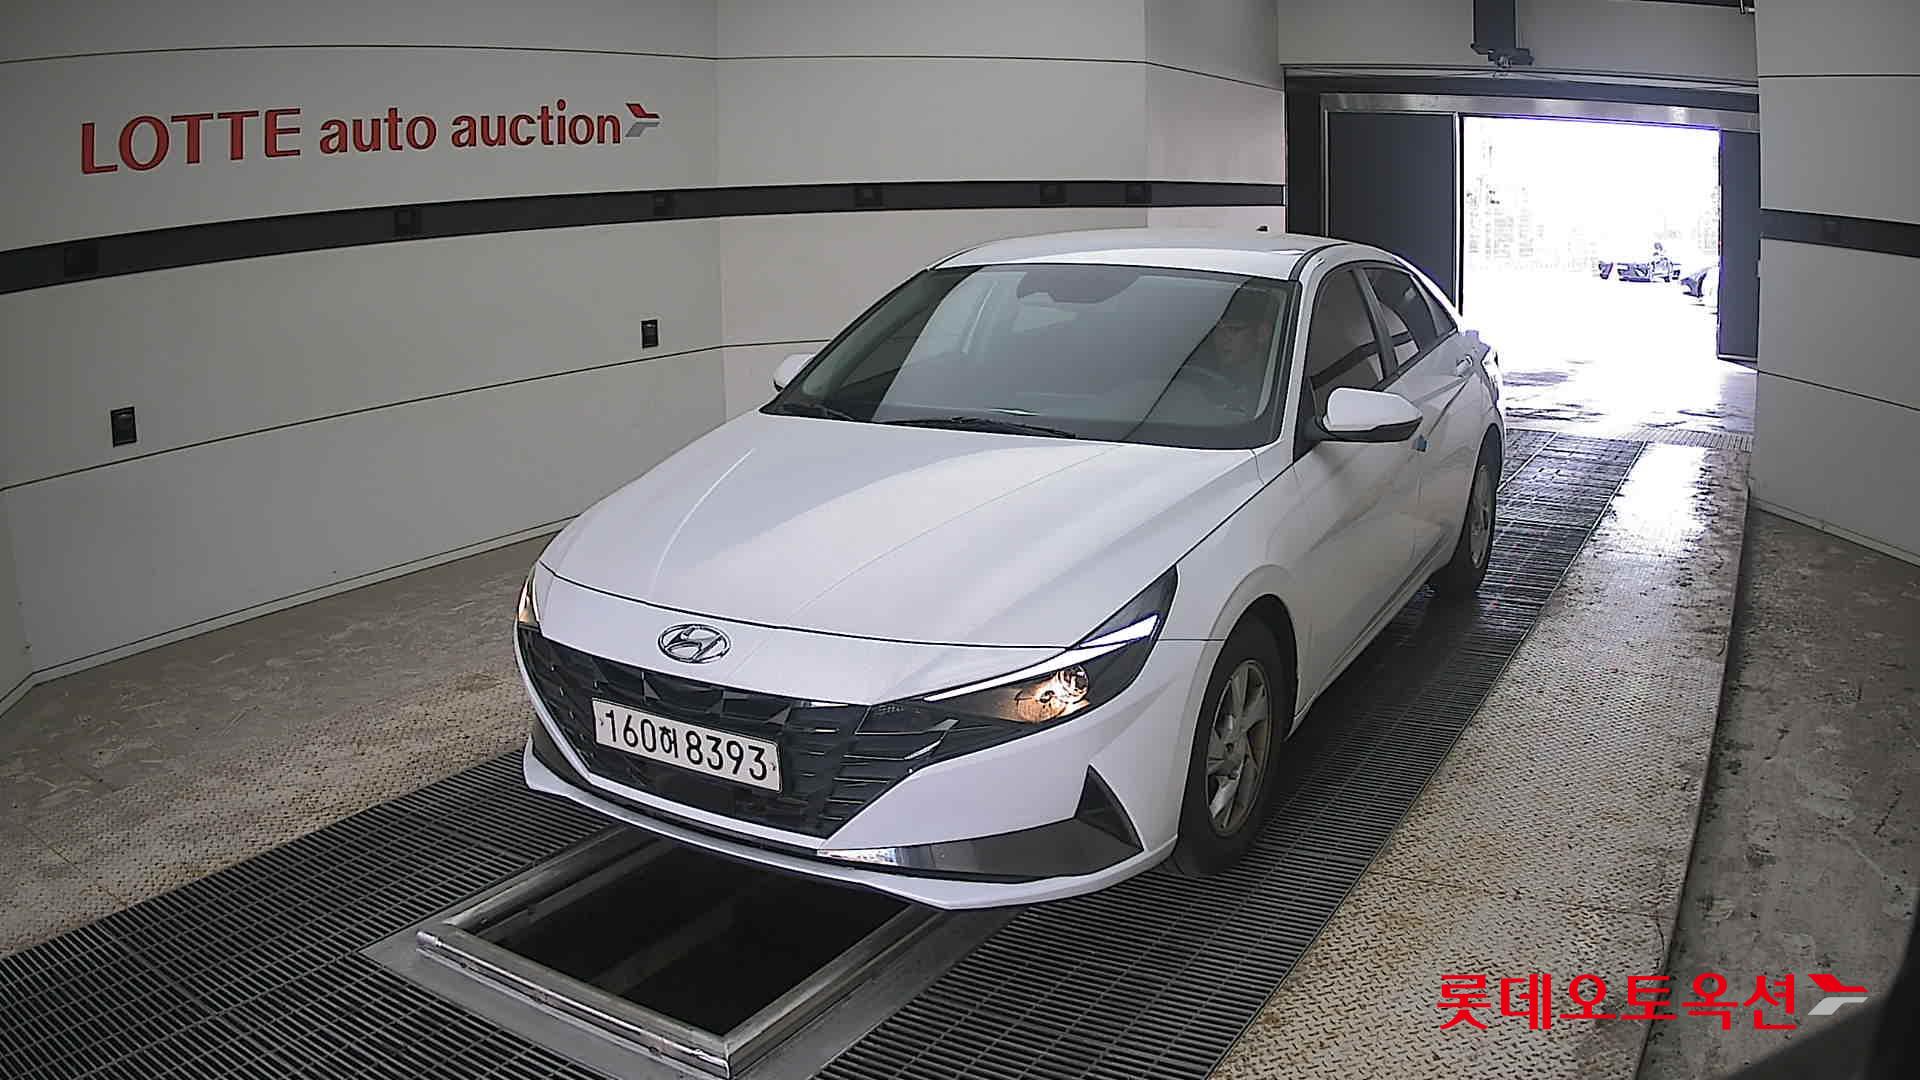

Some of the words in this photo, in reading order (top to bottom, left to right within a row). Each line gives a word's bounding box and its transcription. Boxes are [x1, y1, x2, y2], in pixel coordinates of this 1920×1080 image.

[82, 108, 301, 174] LOTTE
[319, 107, 437, 154] auto
[451, 99, 622, 147] auction
